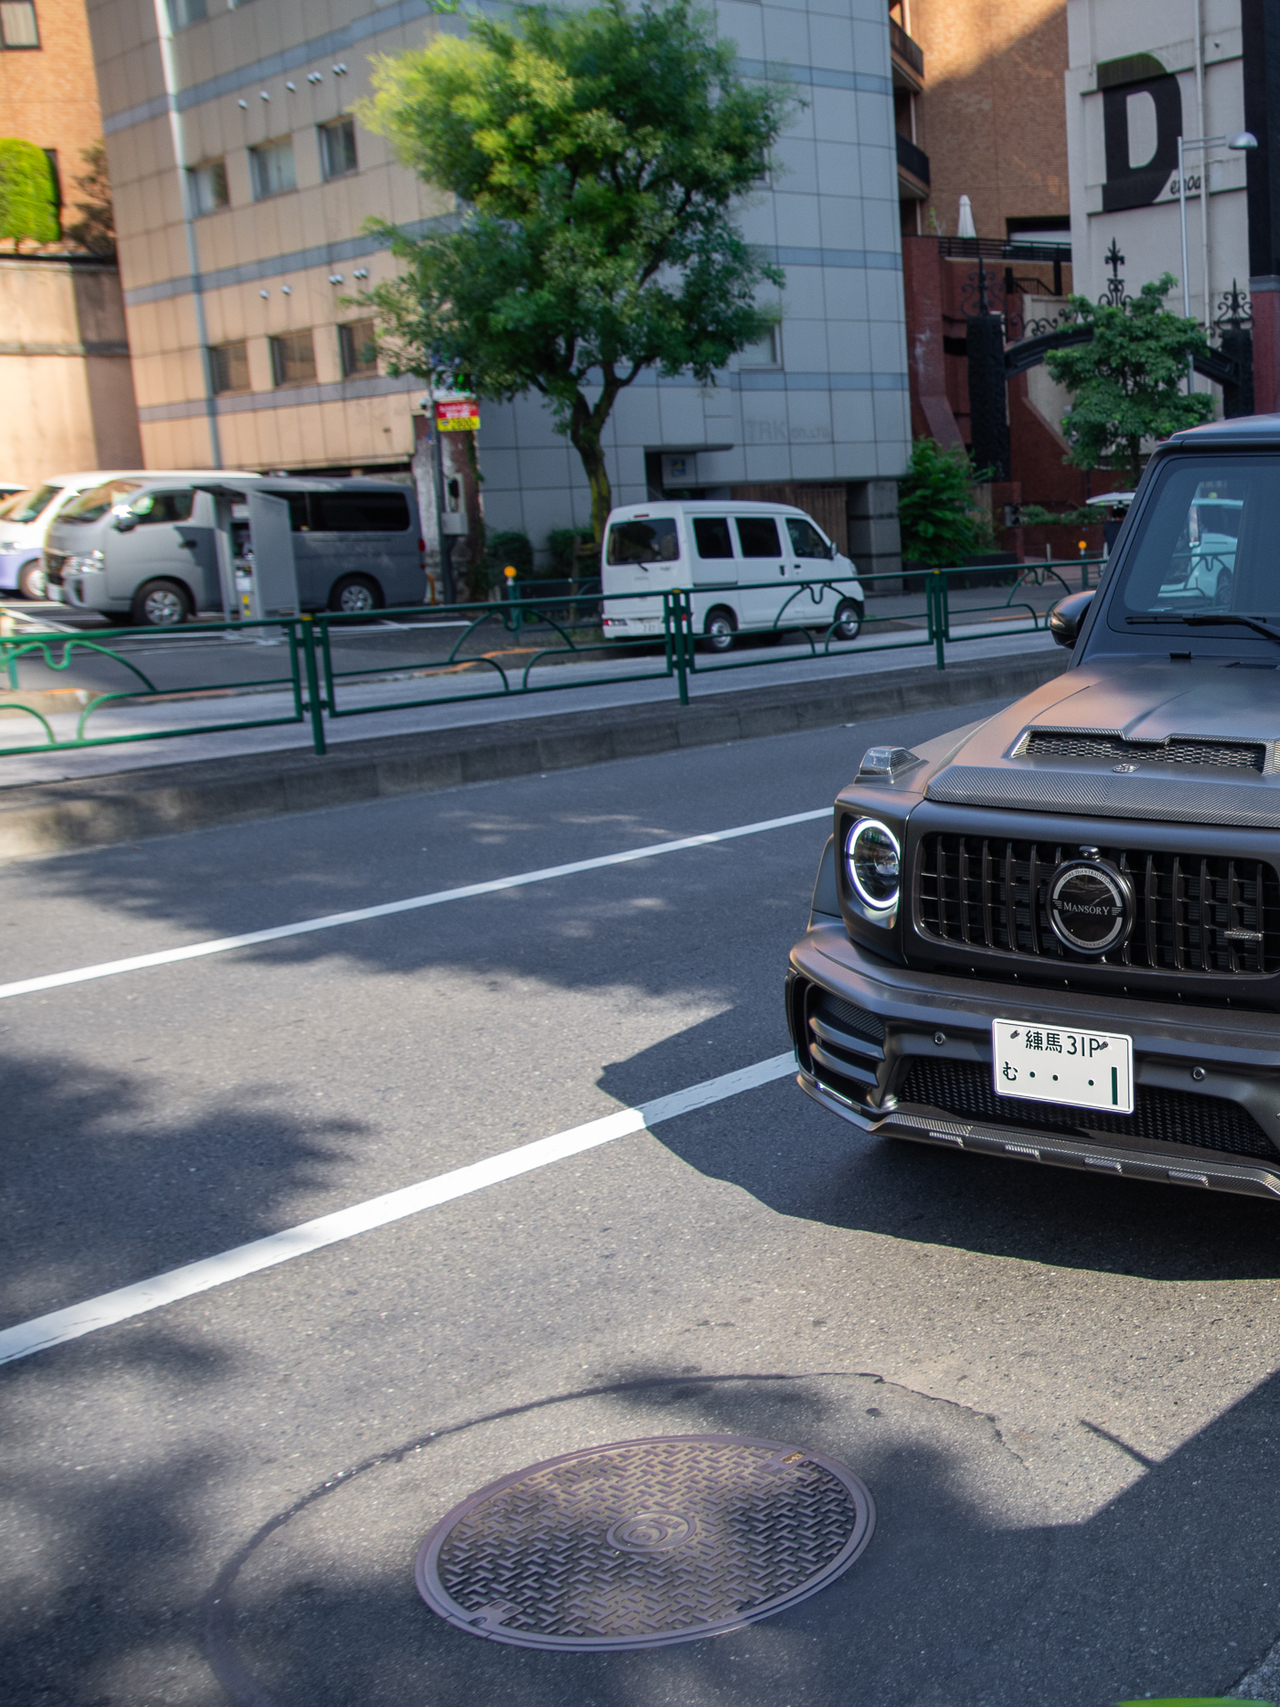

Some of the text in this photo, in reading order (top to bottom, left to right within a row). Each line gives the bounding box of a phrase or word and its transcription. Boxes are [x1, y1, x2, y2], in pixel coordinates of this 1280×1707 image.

[1025, 1030, 1101, 1058] 練馬 31P
[1002, 1061, 1018, 1081] む
